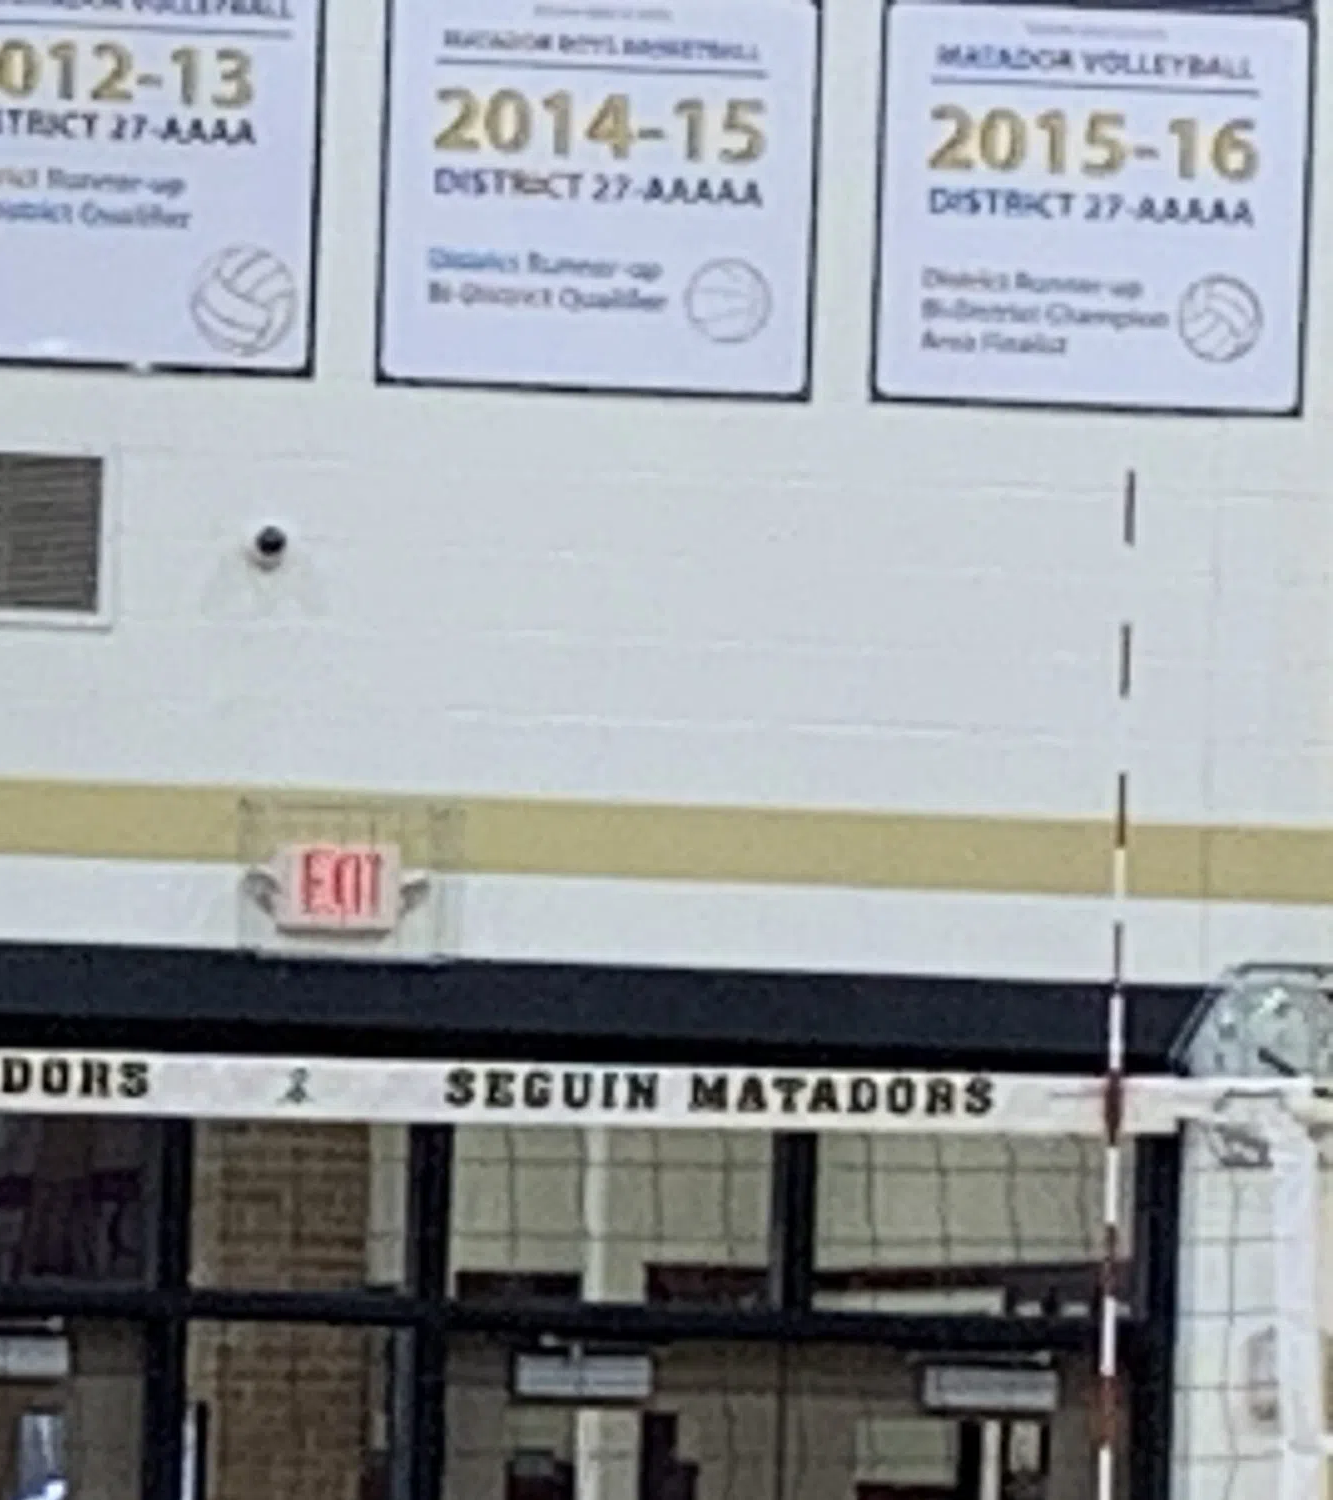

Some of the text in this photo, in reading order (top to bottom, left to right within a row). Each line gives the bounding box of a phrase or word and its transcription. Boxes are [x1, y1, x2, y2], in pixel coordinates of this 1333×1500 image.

[936, 44, 1254, 80] MATADOR VOLLEYBALL
[110, 113, 257, 145] 27-AAAA
[434, 87, 768, 164] 2014-15
[928, 104, 1259, 181] 2015-16
[433, 167, 764, 208] DISTRICT 27-AAAAA
[928, 187, 1254, 228] DISTRICT 27-AAAAA
[299, 847, 384, 916] EXIT
[443, 1067, 996, 1116] SEGUIN MATADORS
